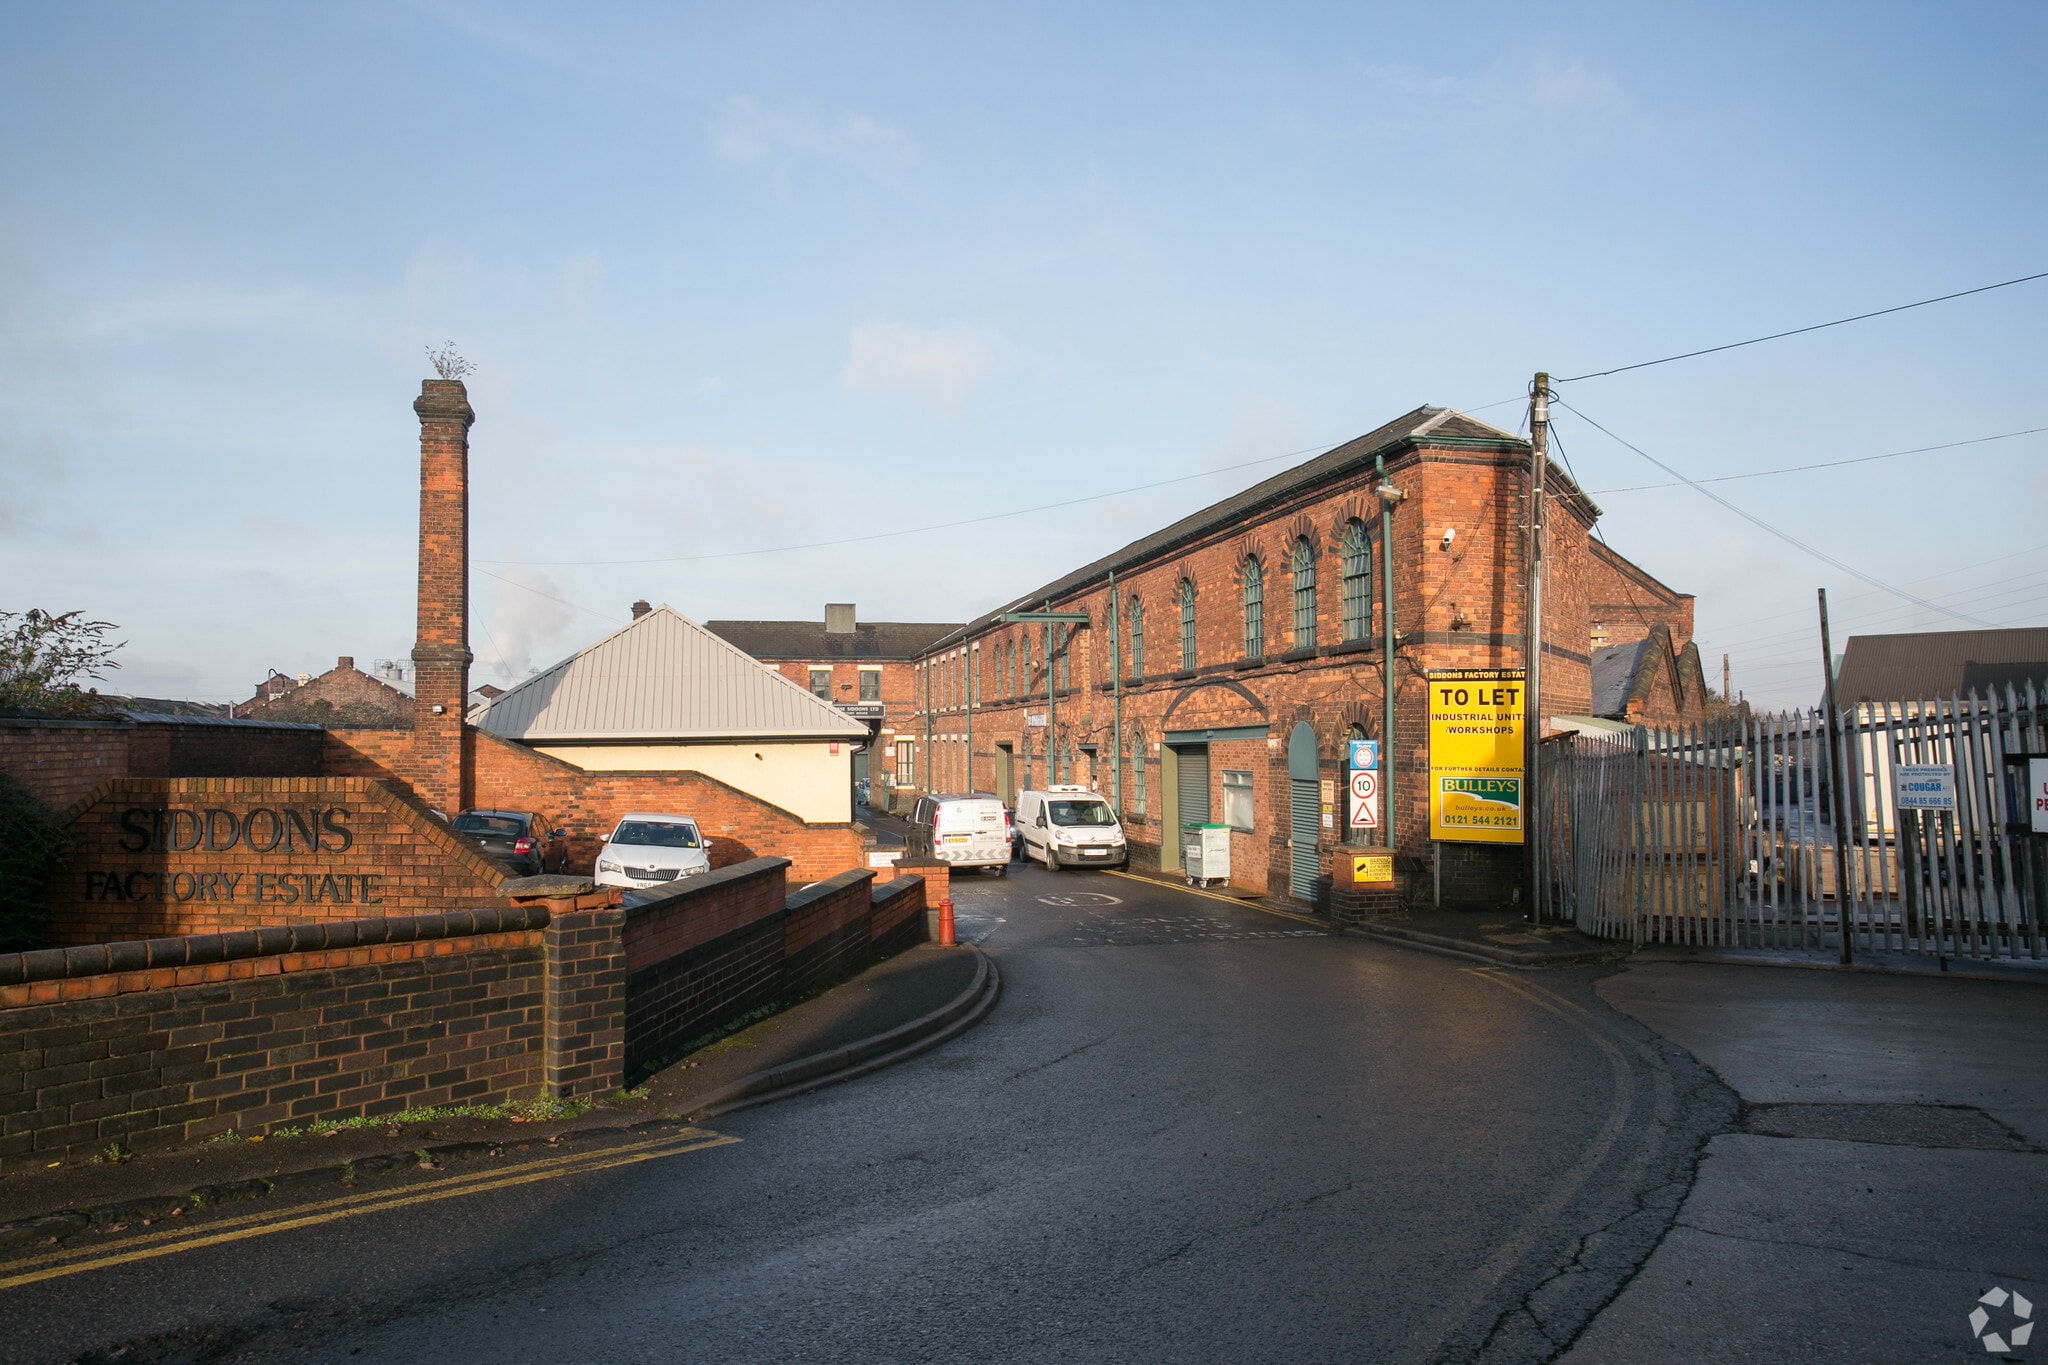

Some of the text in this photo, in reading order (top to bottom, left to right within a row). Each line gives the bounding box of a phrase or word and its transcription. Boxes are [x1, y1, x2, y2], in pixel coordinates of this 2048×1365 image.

[1440, 689, 1520, 706] TO LET
[1357, 780, 1371, 791] 10
[1444, 780, 1517, 792] BULLEYS
[1908, 783, 1942, 792] COUGAR
[1445, 815, 1517, 825] 0121 544 2121
[119, 808, 353, 854] SIDDONS
[86, 870, 383, 904] FACTORY ESTATE
